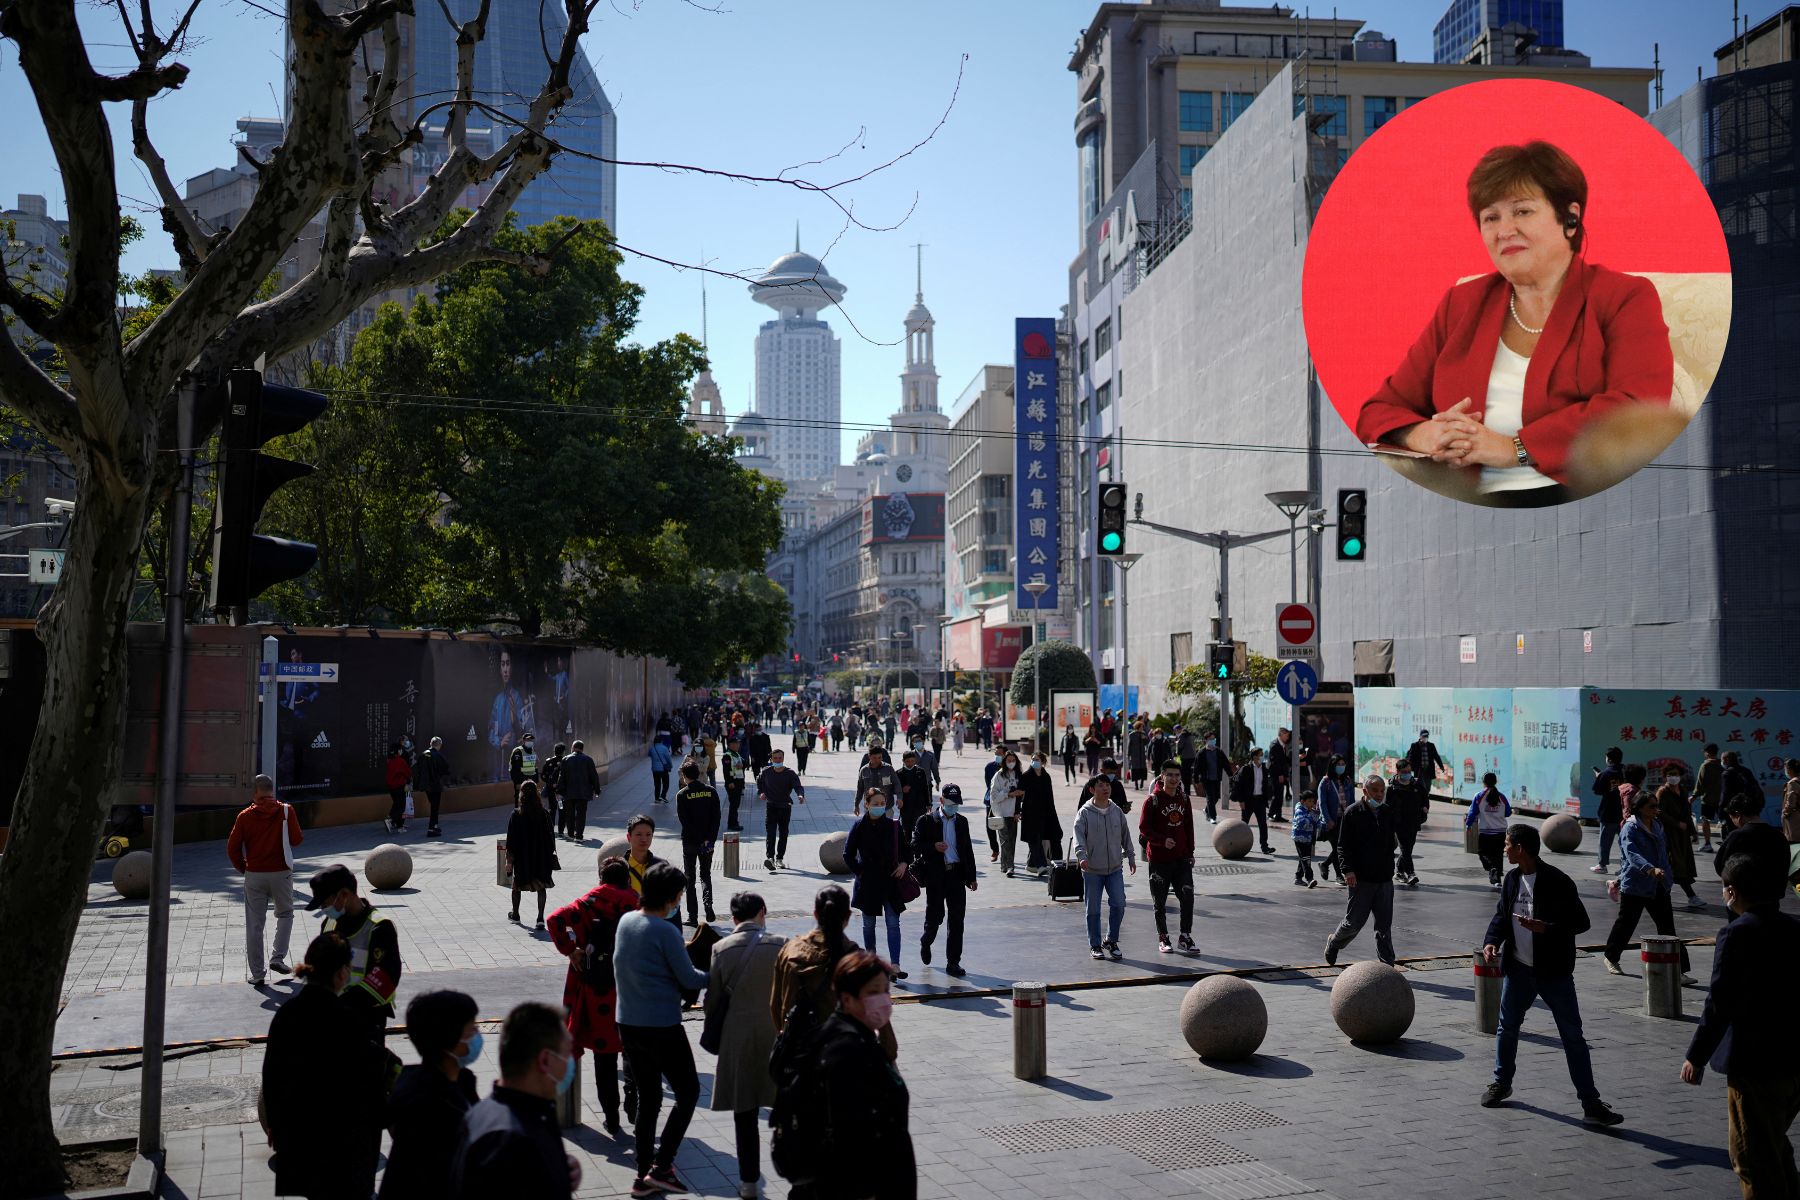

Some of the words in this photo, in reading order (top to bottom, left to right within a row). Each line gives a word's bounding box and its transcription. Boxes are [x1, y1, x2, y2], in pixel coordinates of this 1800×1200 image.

[412, 150, 449, 168] PLA
[1664, 695, 1769, 720] 真老大房
[1619, 725, 1706, 744] 装修期间
[1725, 728, 1800, 745] 正常营
[686, 791, 712, 800] LEAGUE
